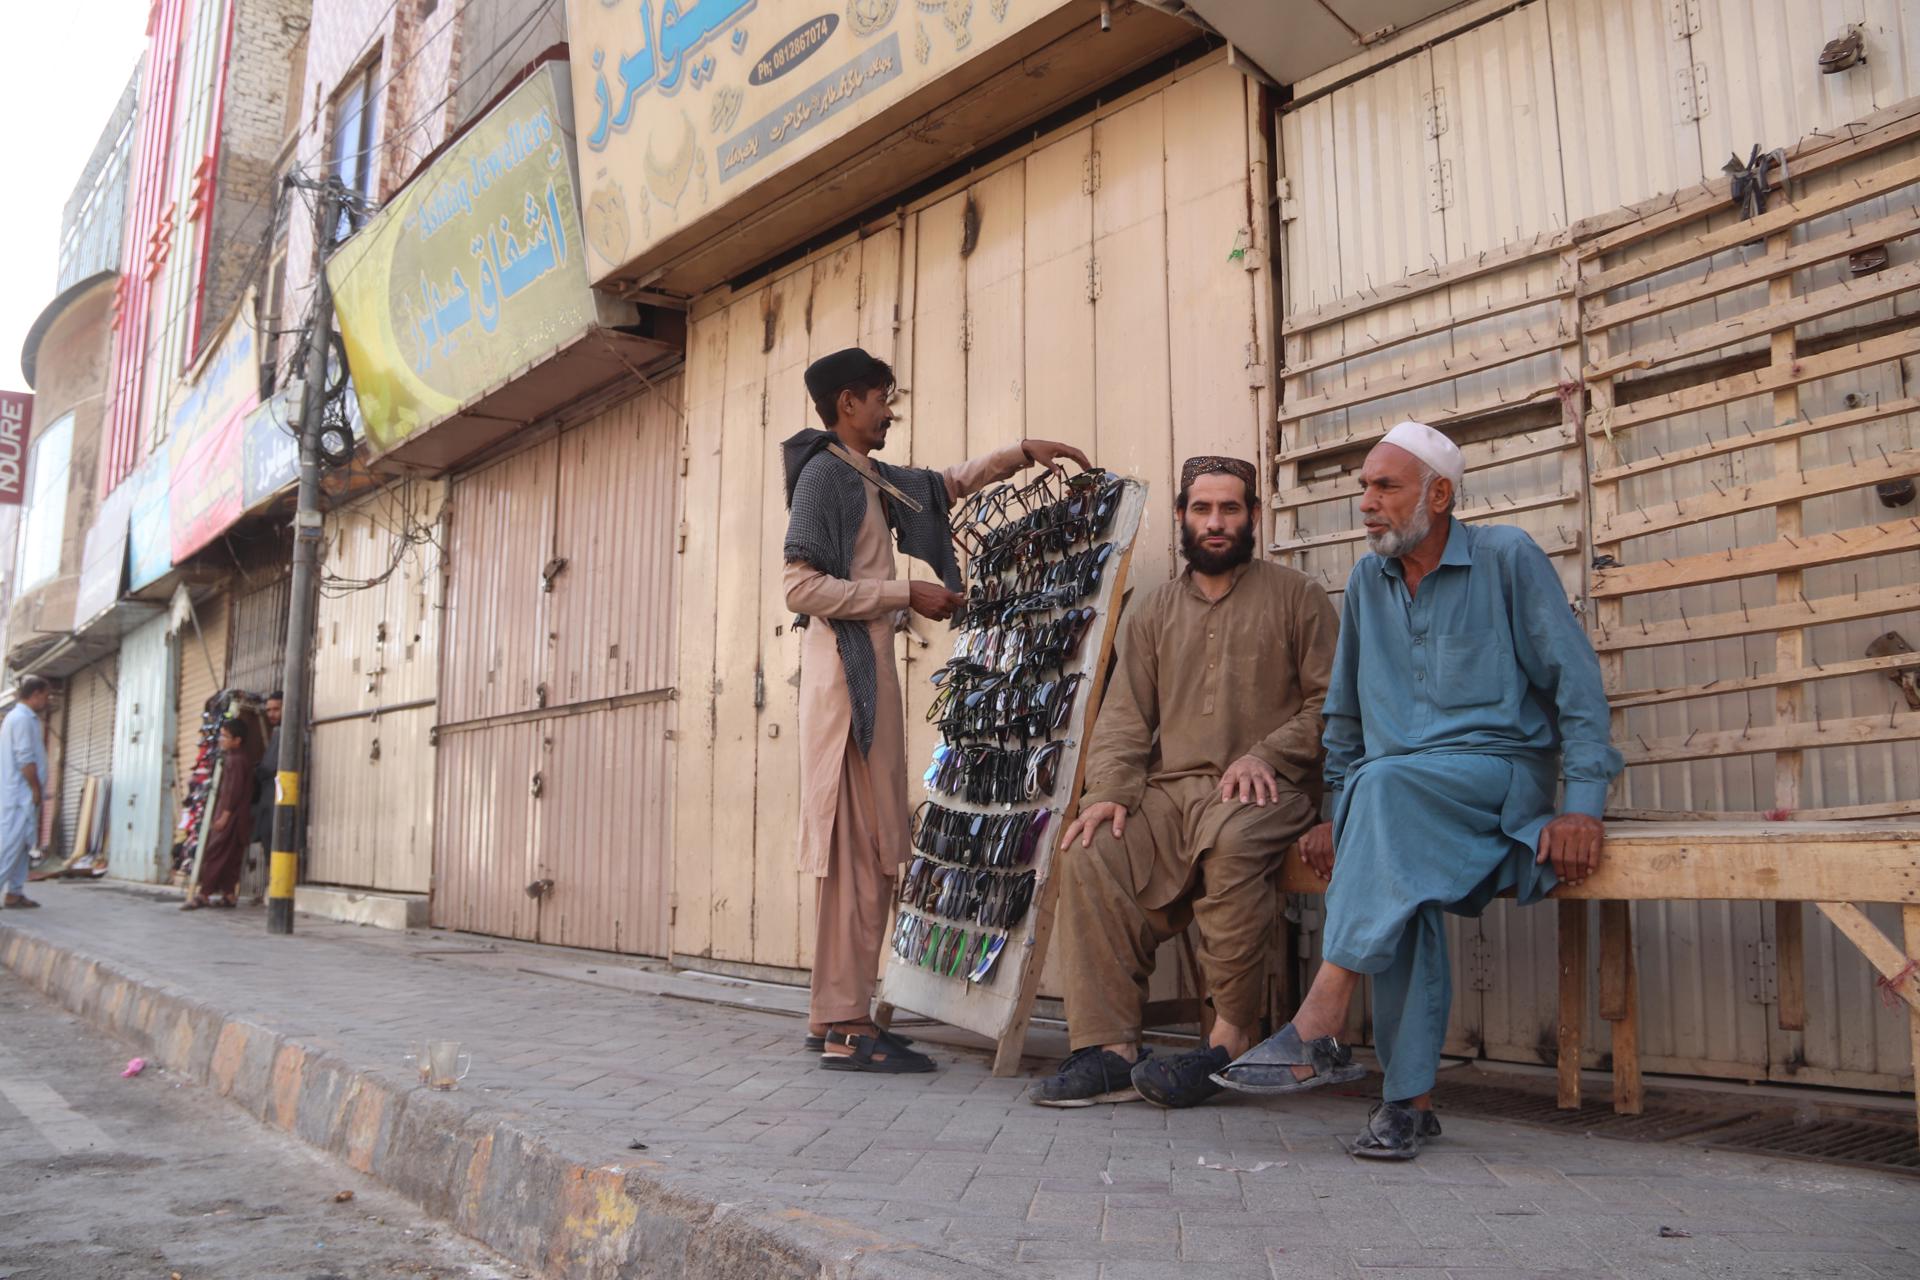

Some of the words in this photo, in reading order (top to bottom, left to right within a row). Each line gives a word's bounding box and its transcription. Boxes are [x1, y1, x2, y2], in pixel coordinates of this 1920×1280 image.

[773, 17, 828, 69] 0812867074
[469, 106, 552, 197] Jewellers
[471, 177, 567, 334] اشفاق
[0, 398, 23, 494] NDURE
